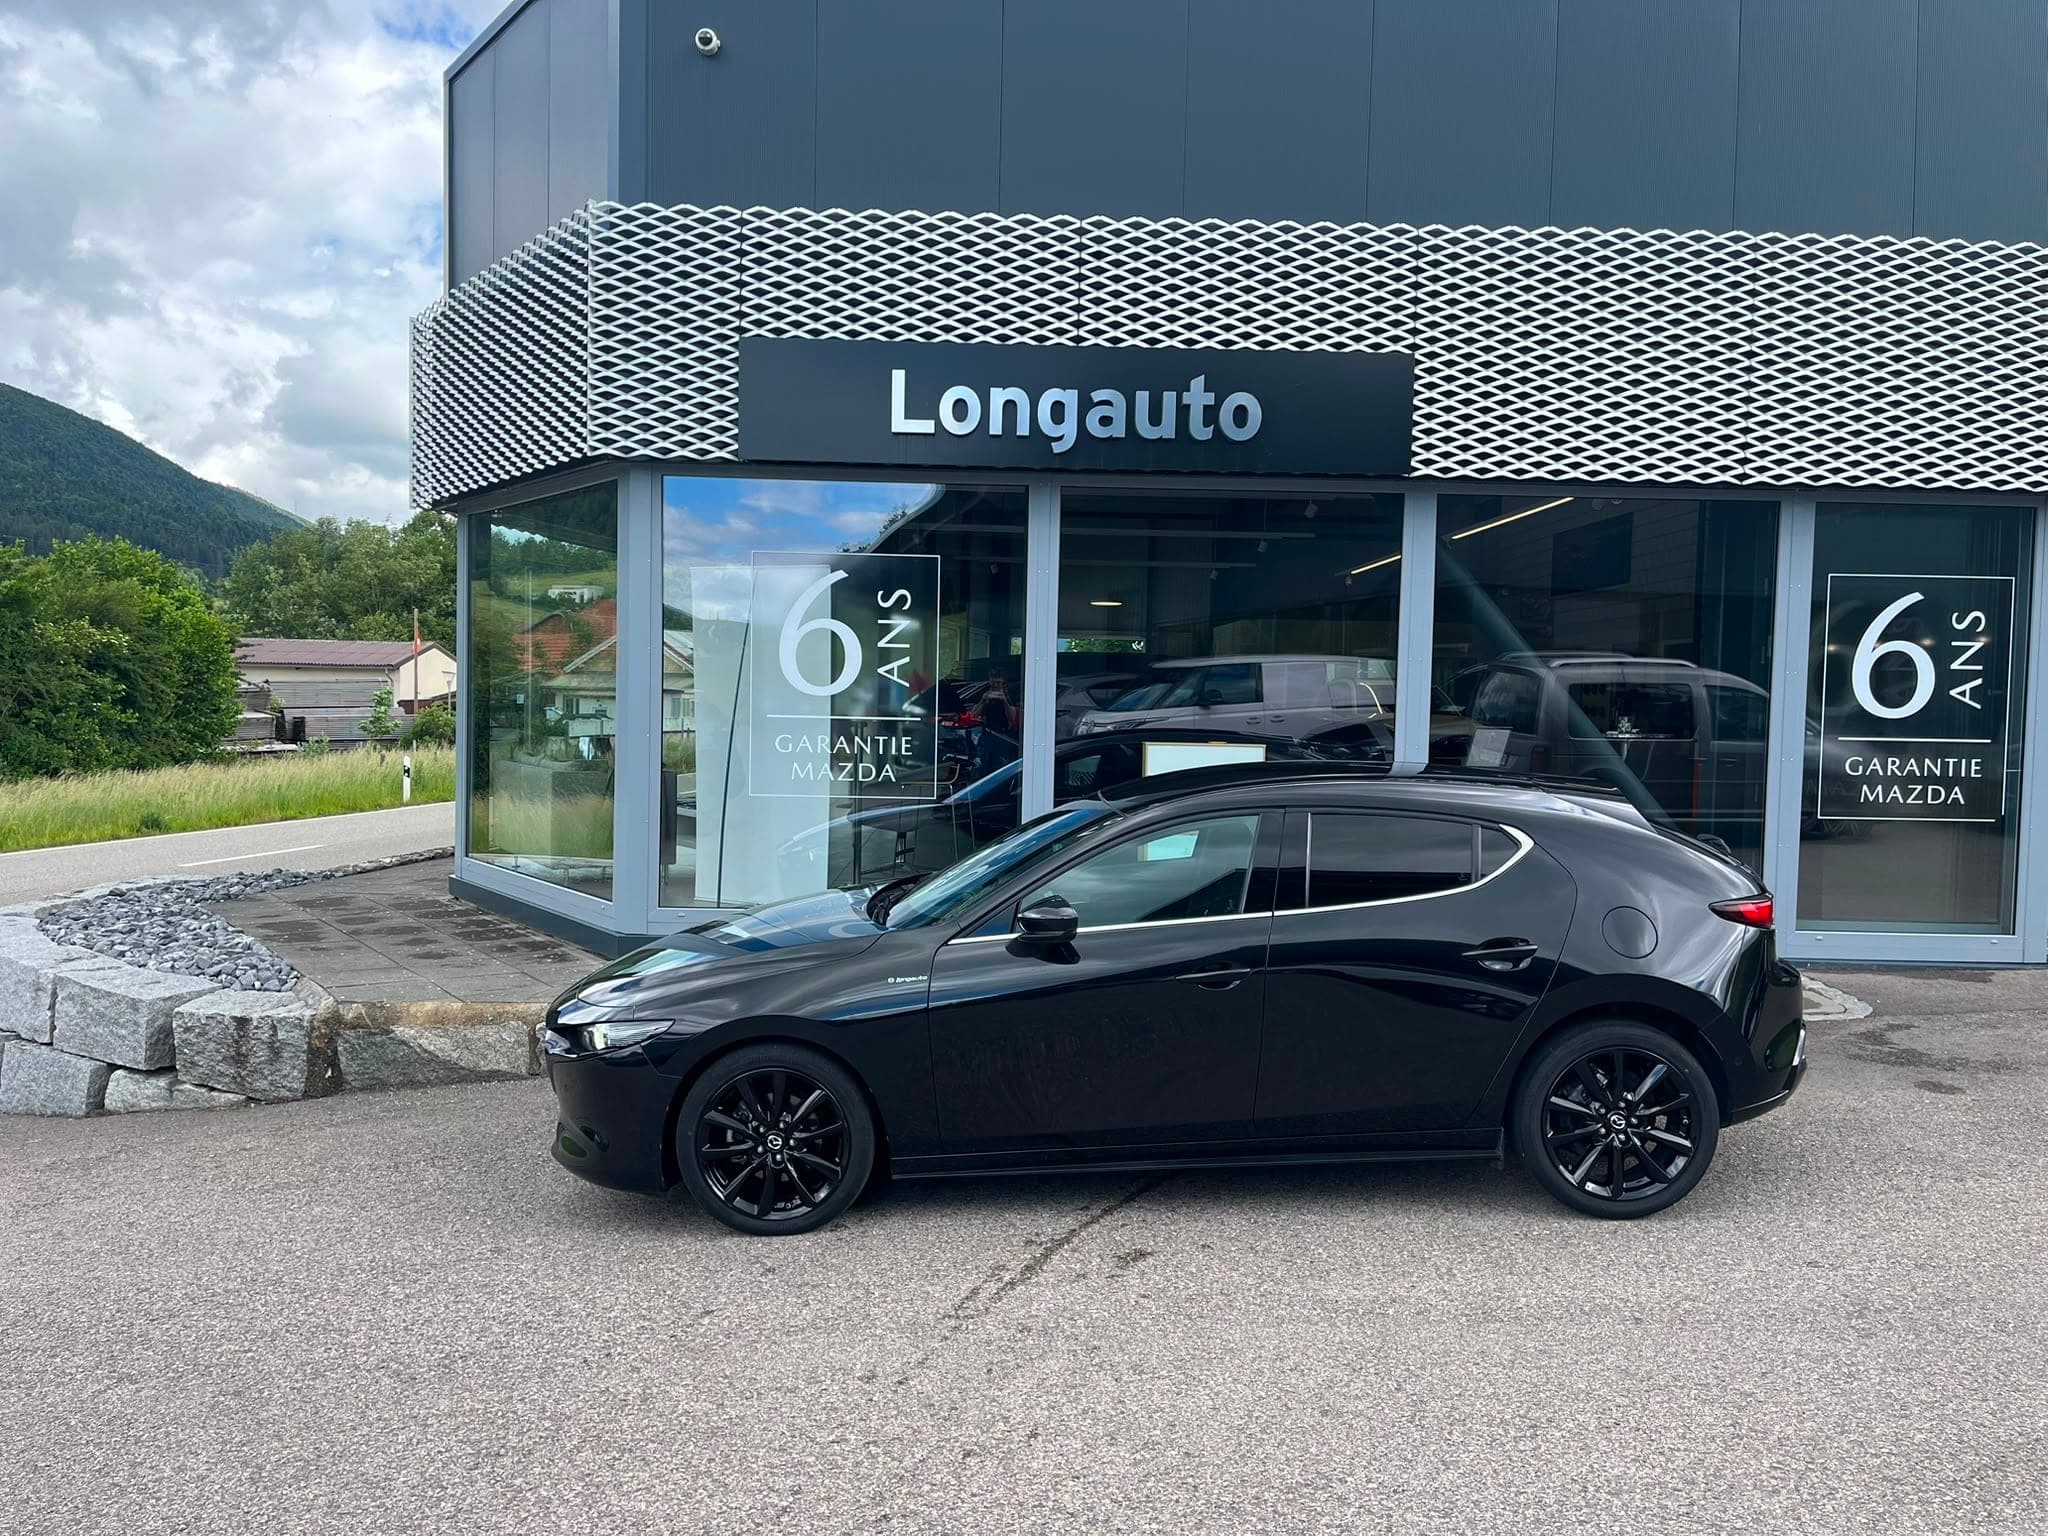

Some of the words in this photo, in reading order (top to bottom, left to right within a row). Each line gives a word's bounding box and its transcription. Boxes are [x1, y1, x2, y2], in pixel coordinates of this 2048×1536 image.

[890, 368, 1263, 454] Longauto
[778, 568, 863, 697] 6
[876, 587, 912, 688] ANS
[1851, 591, 1936, 720] 6
[1949, 610, 1986, 710] ANS
[774, 733, 914, 756] GARANTIE
[790, 761, 897, 783] MAZDA
[1844, 756, 1983, 778] GARANTIE
[1859, 784, 1966, 805] MAZDA
